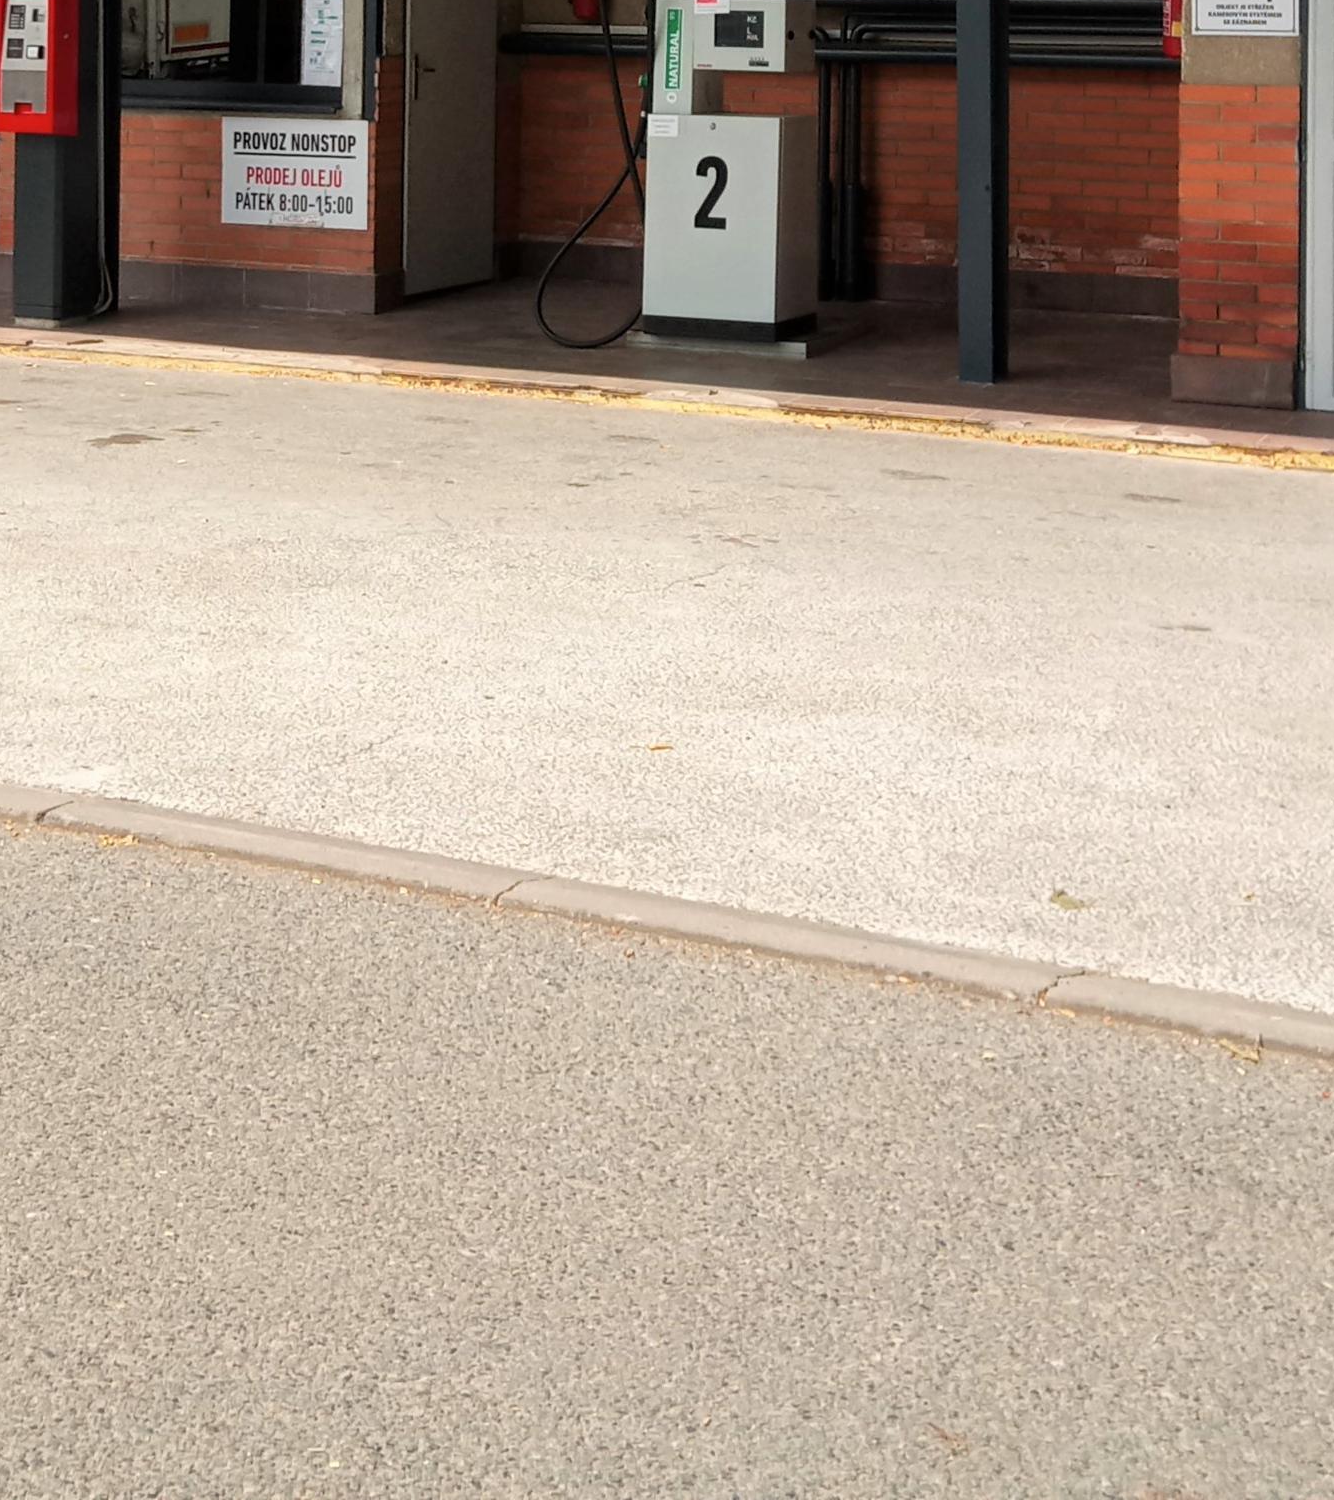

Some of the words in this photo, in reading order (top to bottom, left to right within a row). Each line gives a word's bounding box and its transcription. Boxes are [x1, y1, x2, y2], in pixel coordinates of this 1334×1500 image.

[668, 30, 681, 88] NATURAL
[233, 131, 287, 151] PROVOZ
[291, 133, 357, 153] NONSTOP
[246, 166, 297, 186] PRODEJ
[301, 164, 343, 188] OLEJŮ
[235, 187, 275, 211] PÁTEK
[694, 155, 729, 230] 2
